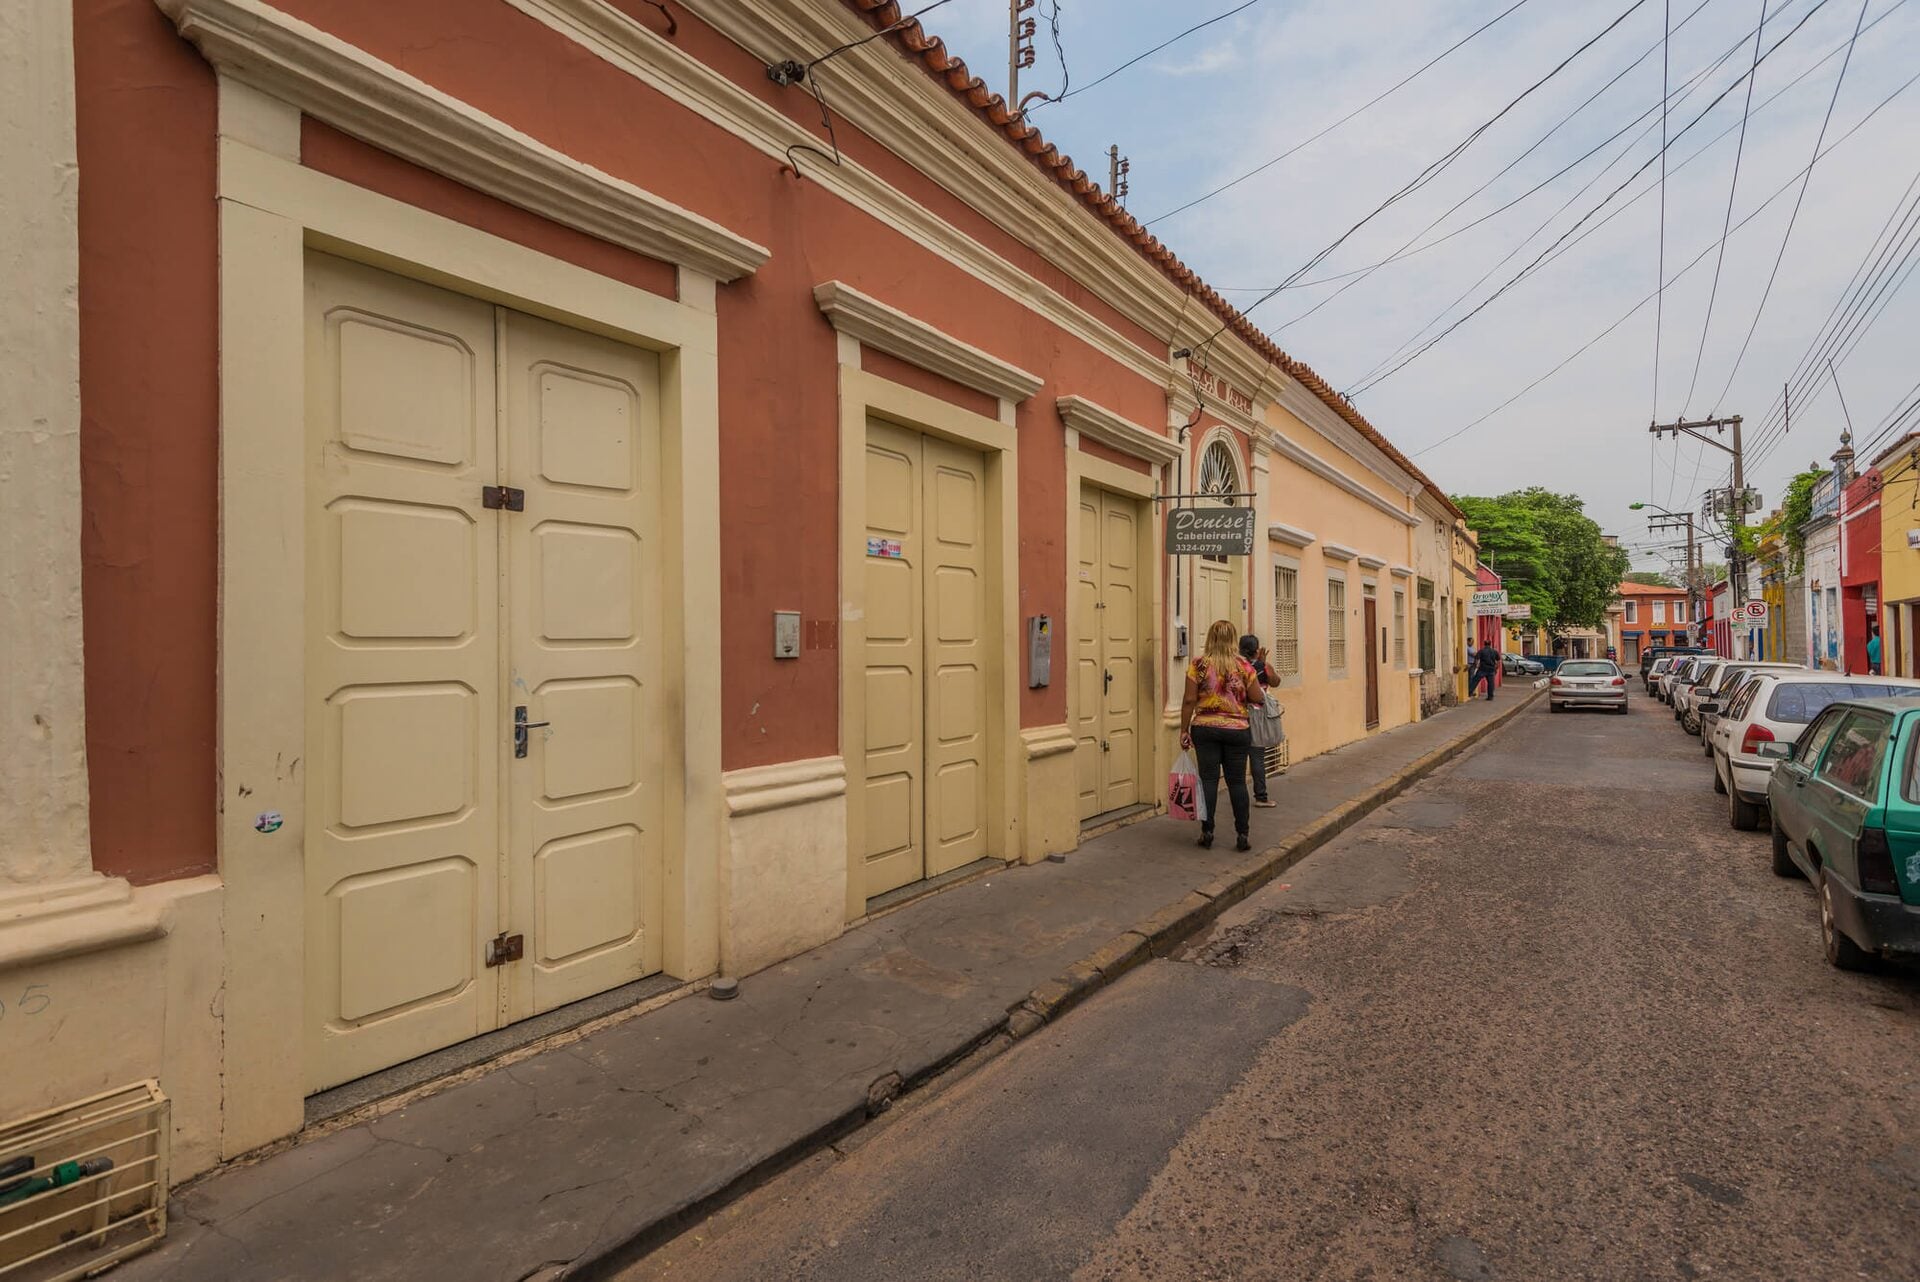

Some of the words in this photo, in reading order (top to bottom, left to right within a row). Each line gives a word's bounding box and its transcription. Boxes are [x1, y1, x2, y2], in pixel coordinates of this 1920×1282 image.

[1176, 511, 1244, 529] Denise
[1176, 531, 1242, 540] Cabeleireira
[1243, 510, 1254, 554] XEROX
[1176, 544, 1222, 552] 3324-0779
